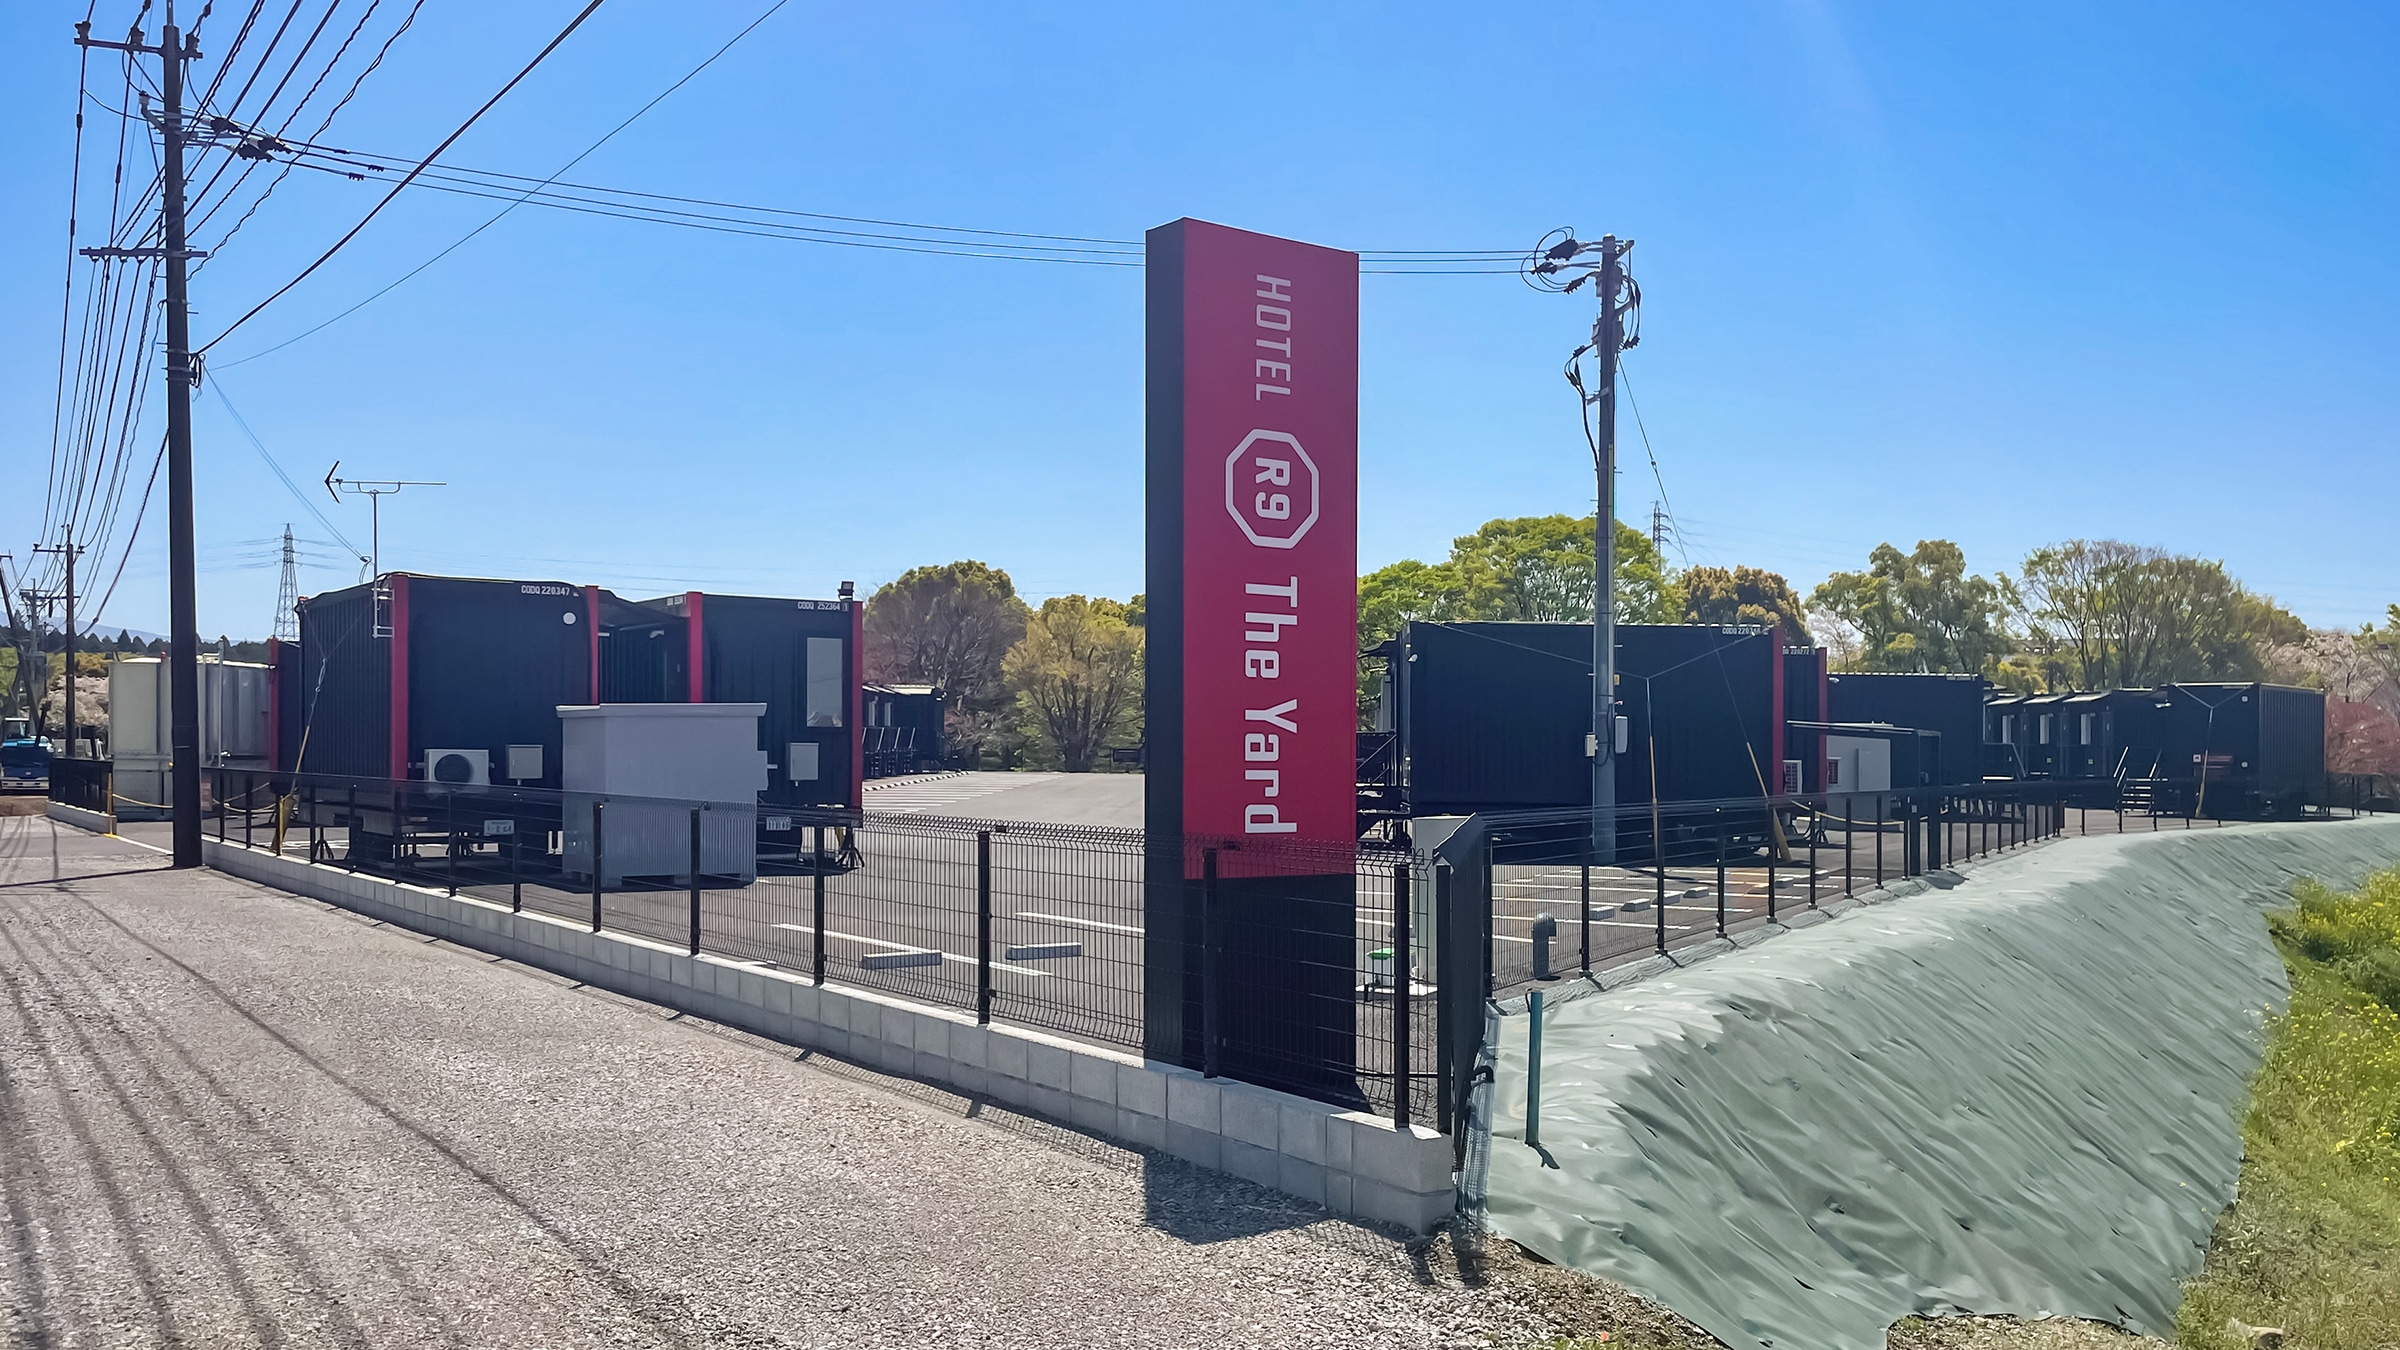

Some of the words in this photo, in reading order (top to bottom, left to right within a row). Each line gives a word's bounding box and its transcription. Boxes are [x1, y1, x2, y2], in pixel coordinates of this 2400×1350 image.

[1256, 274, 1291, 401] HOTEL
[1255, 456, 1291, 521] R9
[541, 586, 570, 596] 220347
[1245, 576, 1297, 679] The
[1245, 698, 1297, 834] Yard
